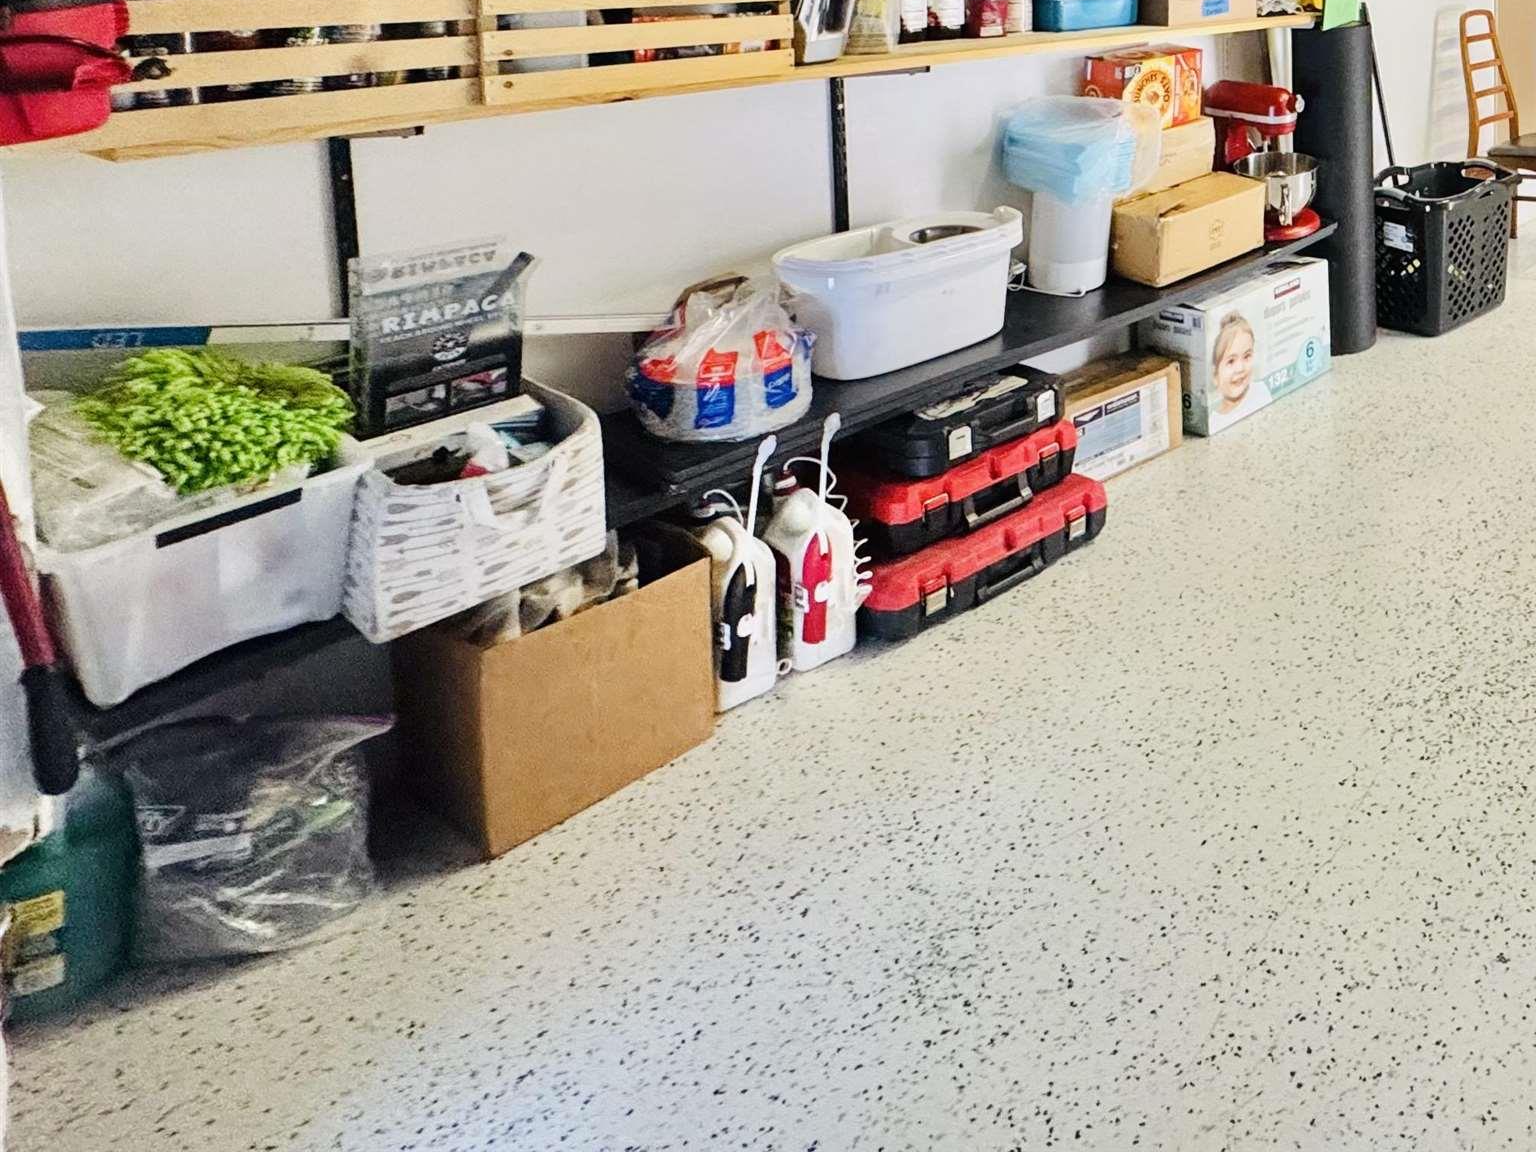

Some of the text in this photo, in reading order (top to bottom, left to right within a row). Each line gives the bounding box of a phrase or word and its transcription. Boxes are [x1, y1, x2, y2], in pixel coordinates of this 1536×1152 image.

[381, 292, 515, 335] RIMPACA
[1306, 341, 1314, 358] 6
[1182, 394, 1192, 408] 6
